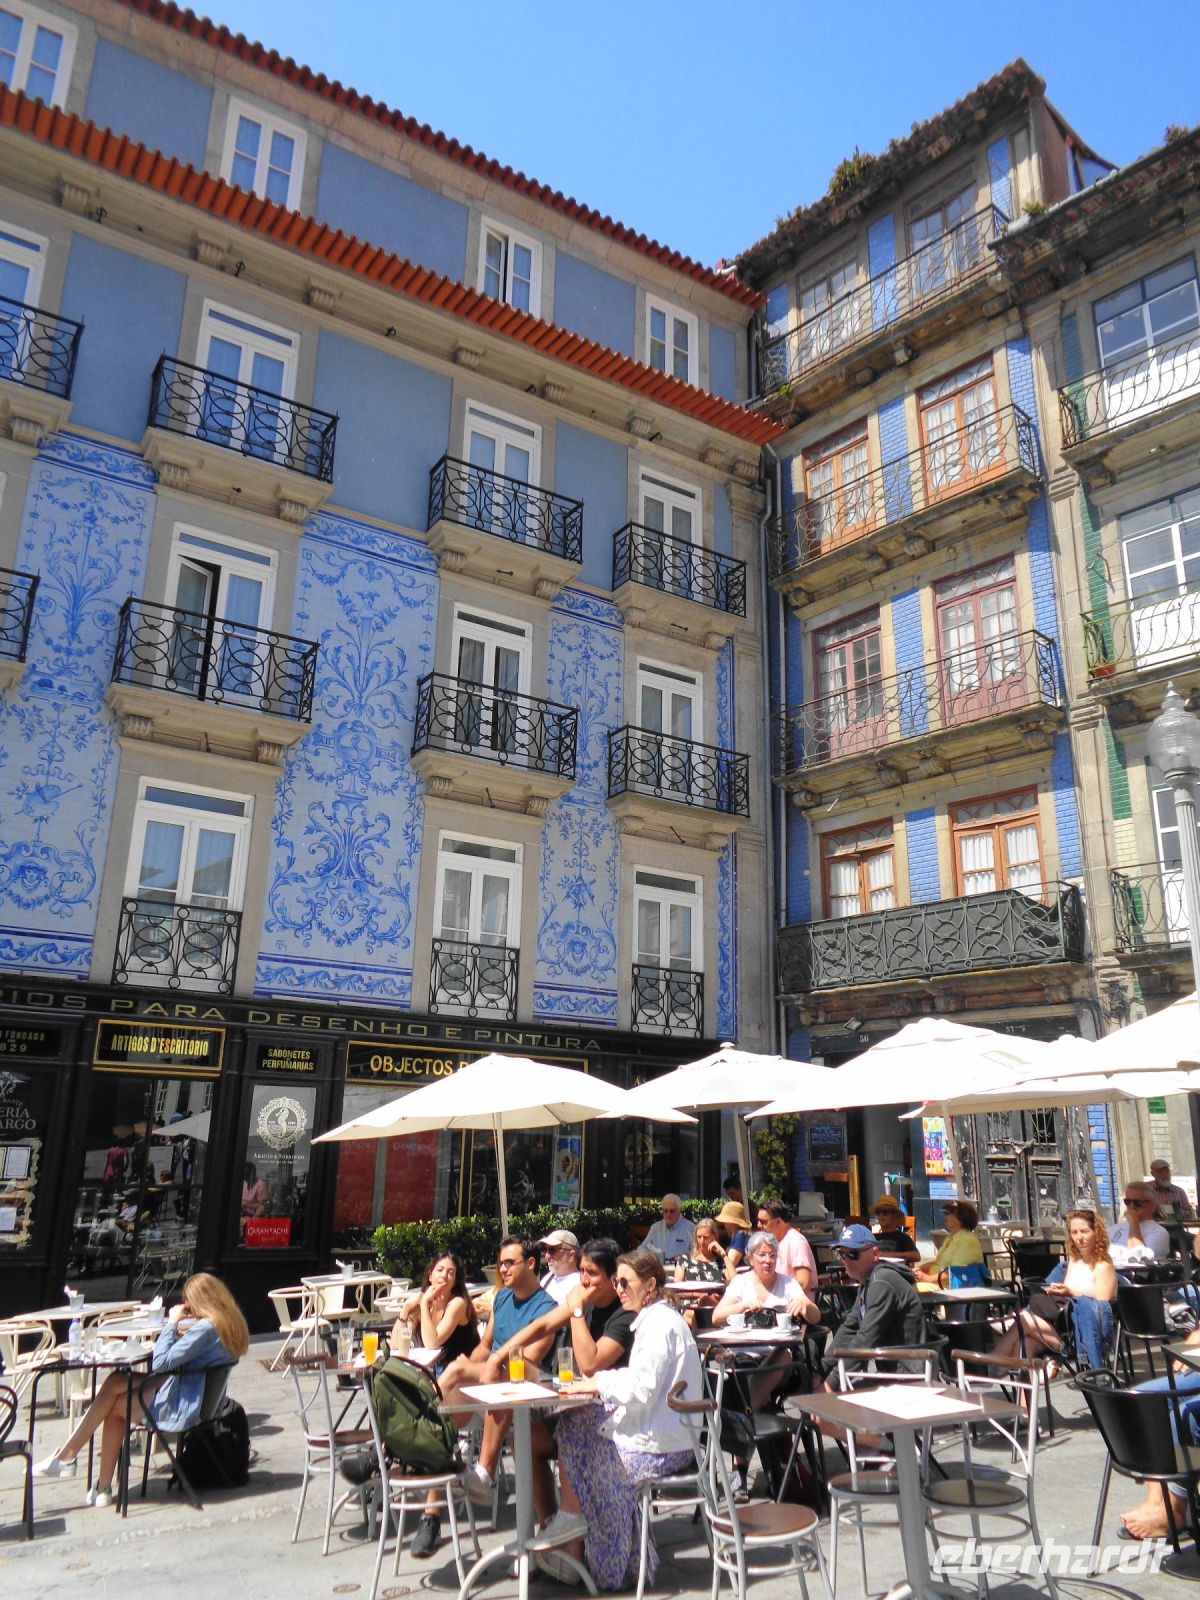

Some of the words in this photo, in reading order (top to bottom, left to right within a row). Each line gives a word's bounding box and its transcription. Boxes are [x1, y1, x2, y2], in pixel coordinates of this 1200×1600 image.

[110, 1000, 226, 1021] PARA
[248, 1010, 428, 1037] DESENHO
[445, 1027, 462, 1040] E
[474, 1030, 601, 1050] PINTURA
[111, 1034, 150, 1053] ARTIGOS
[150, 1036, 209, 1057] D'ESCRITORIO
[268, 1048, 311, 1060] SABONETES
[262, 1059, 314, 1071] PERFUMARIAS
[370, 1054, 453, 1076] OBJECTOS
